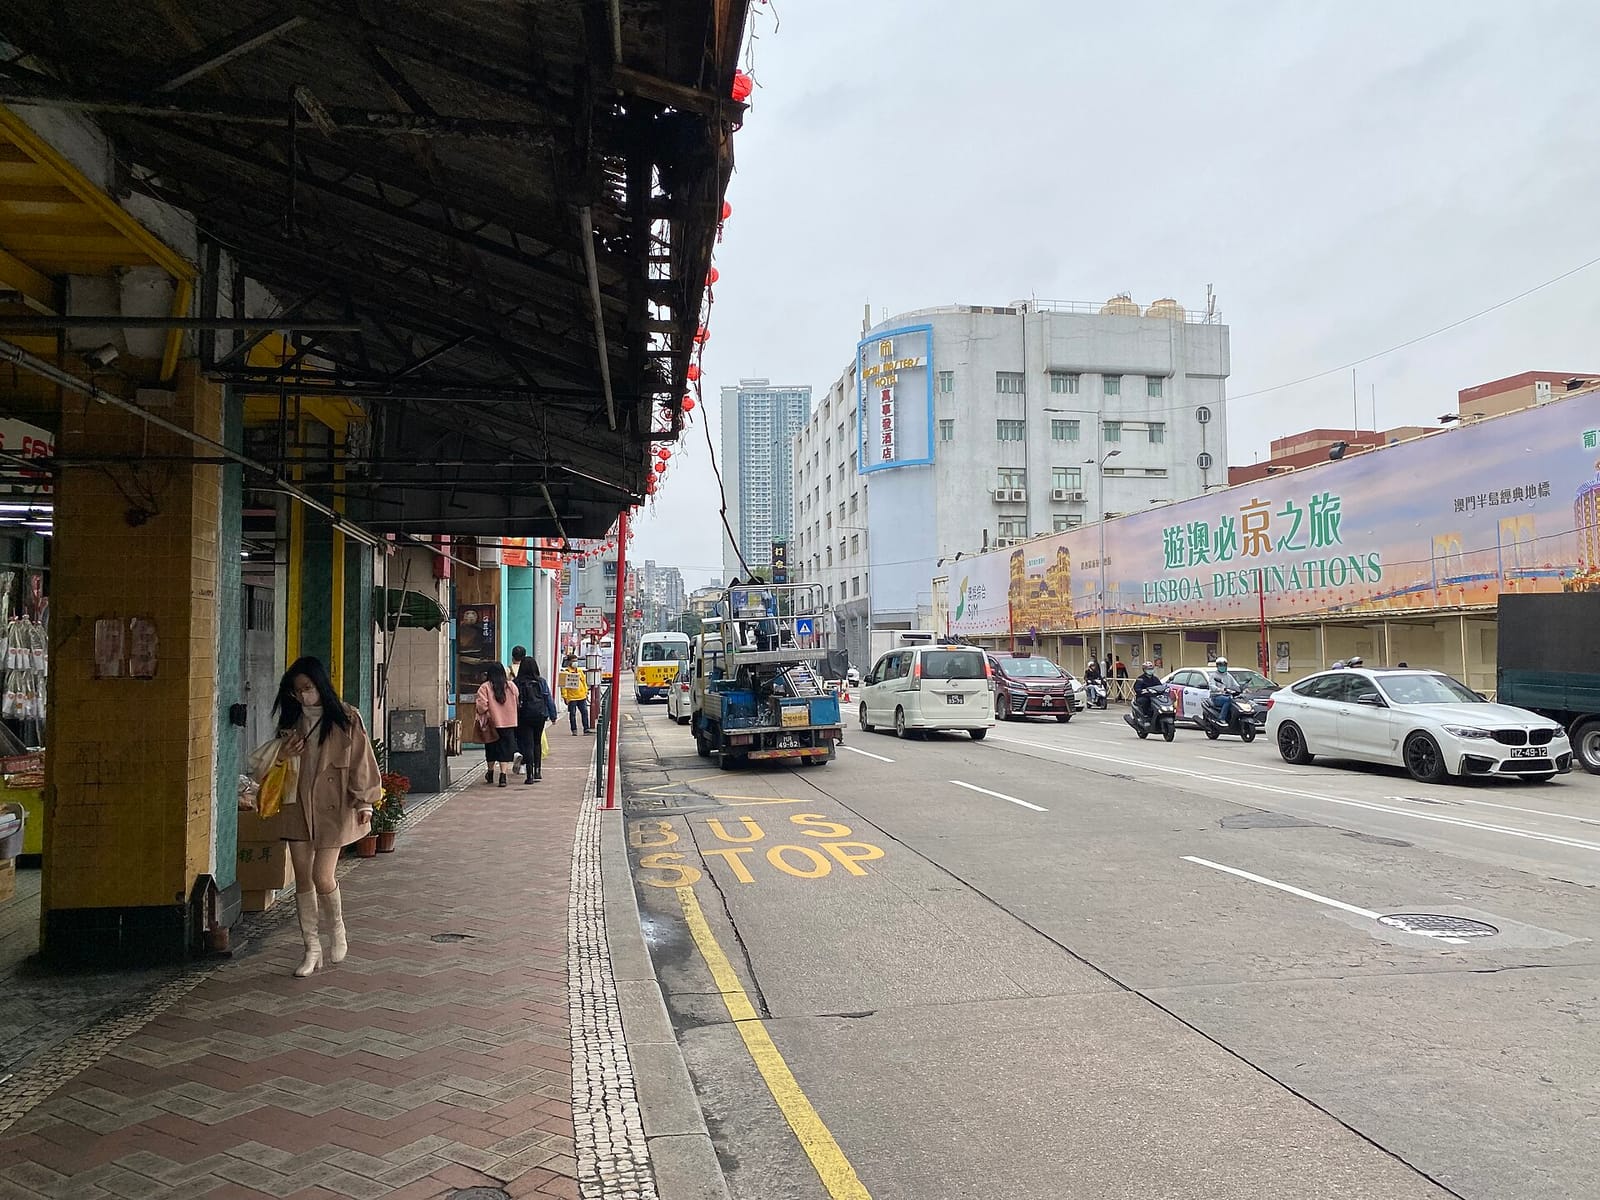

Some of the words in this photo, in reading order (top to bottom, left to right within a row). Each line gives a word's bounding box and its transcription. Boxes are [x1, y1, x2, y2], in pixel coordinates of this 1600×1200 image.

[883, 357, 919, 371] MASTERS
[874, 375, 897, 388] HOTEL
[881, 388, 892, 460] 萬事發酒店
[1583, 429, 1600, 449] 葡
[1454, 480, 1551, 513] 澳門半島經典地標
[1163, 491, 1344, 571] 遊澳必京之旅
[1143, 576, 1205, 604] LISBOA
[1212, 552, 1382, 598] DESTINATIONS
[967, 603, 979, 620] SJM
[629, 813, 852, 848] BUS
[638, 841, 886, 888] STOP
